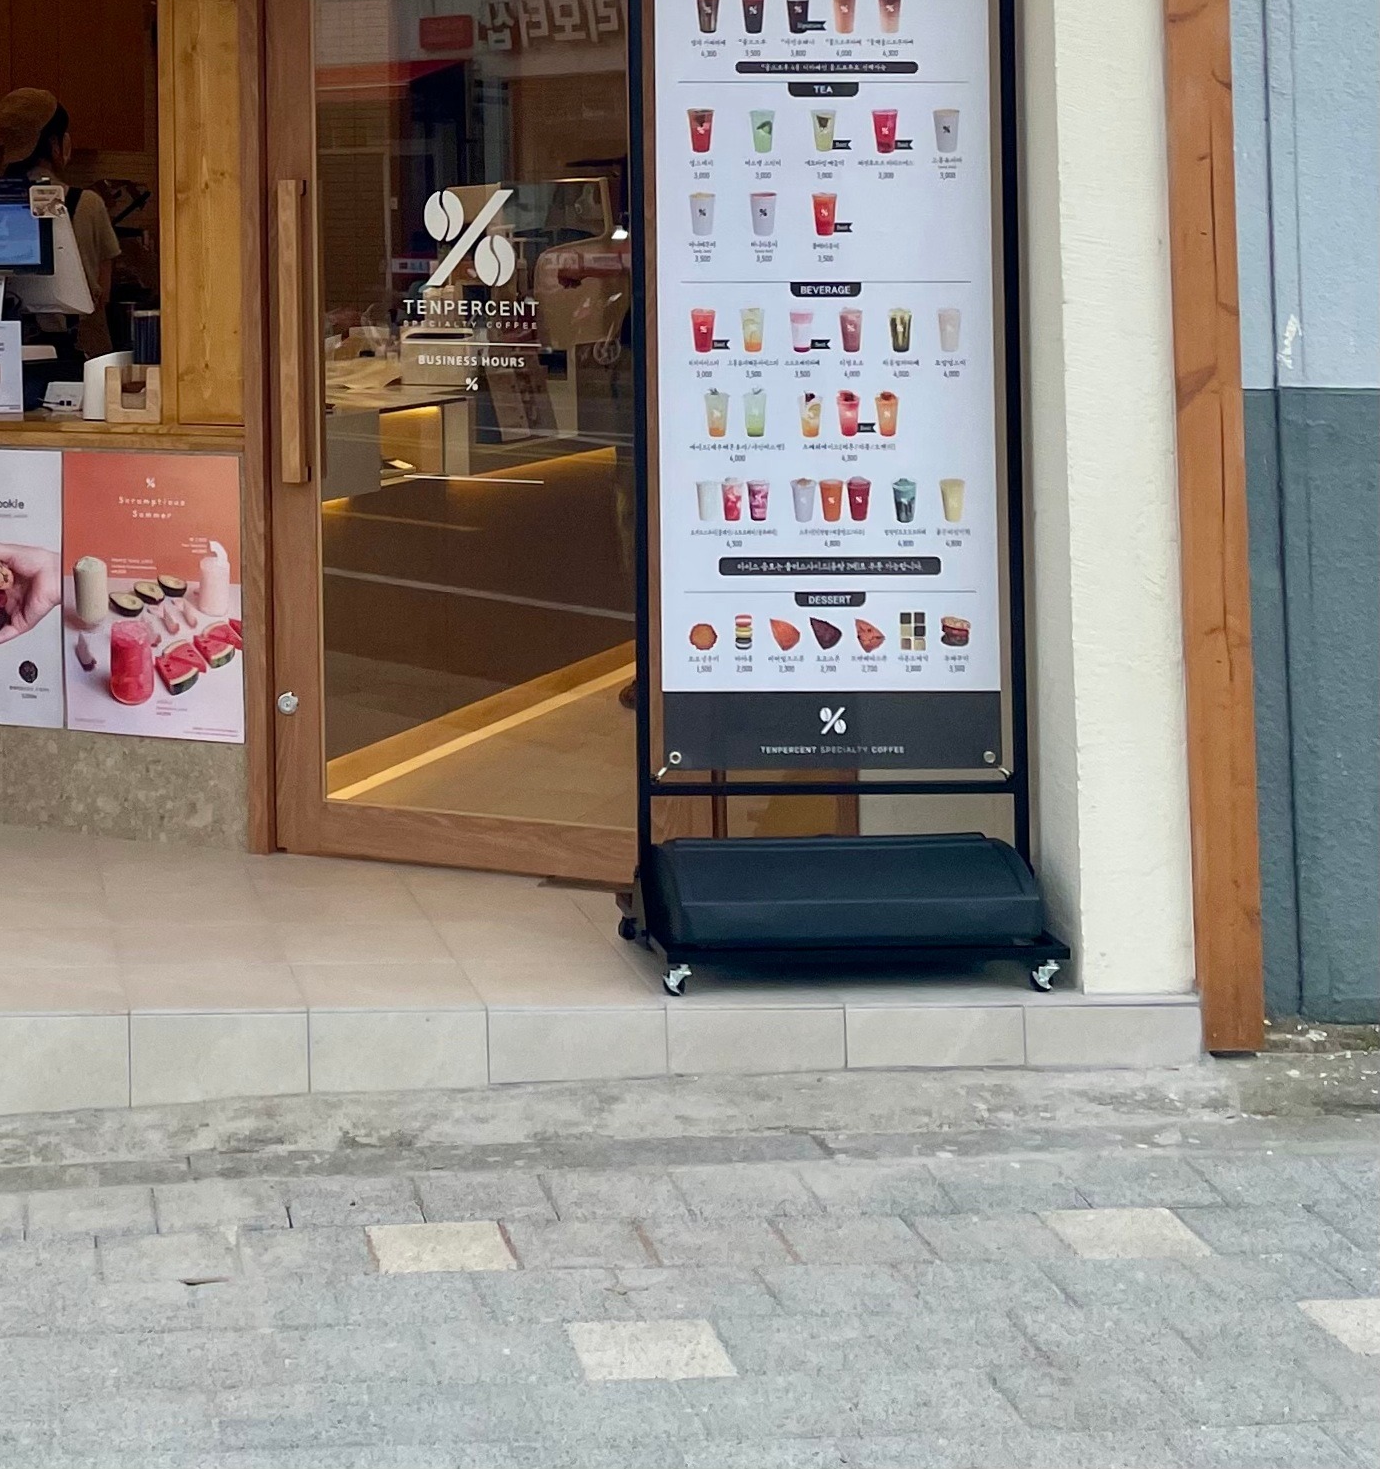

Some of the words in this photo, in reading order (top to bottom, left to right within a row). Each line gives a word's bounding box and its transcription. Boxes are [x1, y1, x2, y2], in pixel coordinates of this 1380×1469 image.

[813, 84, 833, 94] TEA
[800, 285, 851, 295] BEVERAGE
[403, 299, 540, 317] TENPERCENT
[403, 320, 477, 328] SPECIALTY
[486, 321, 538, 330] COFFEE
[418, 355, 477, 366] BUSINESS
[481, 357, 525, 368] HOURS
[808, 594, 852, 605] DESSERT
[760, 745, 817, 755] TENPERCENT
[820, 745, 868, 754] SPECIALTY
[871, 745, 905, 754] COFFEE
